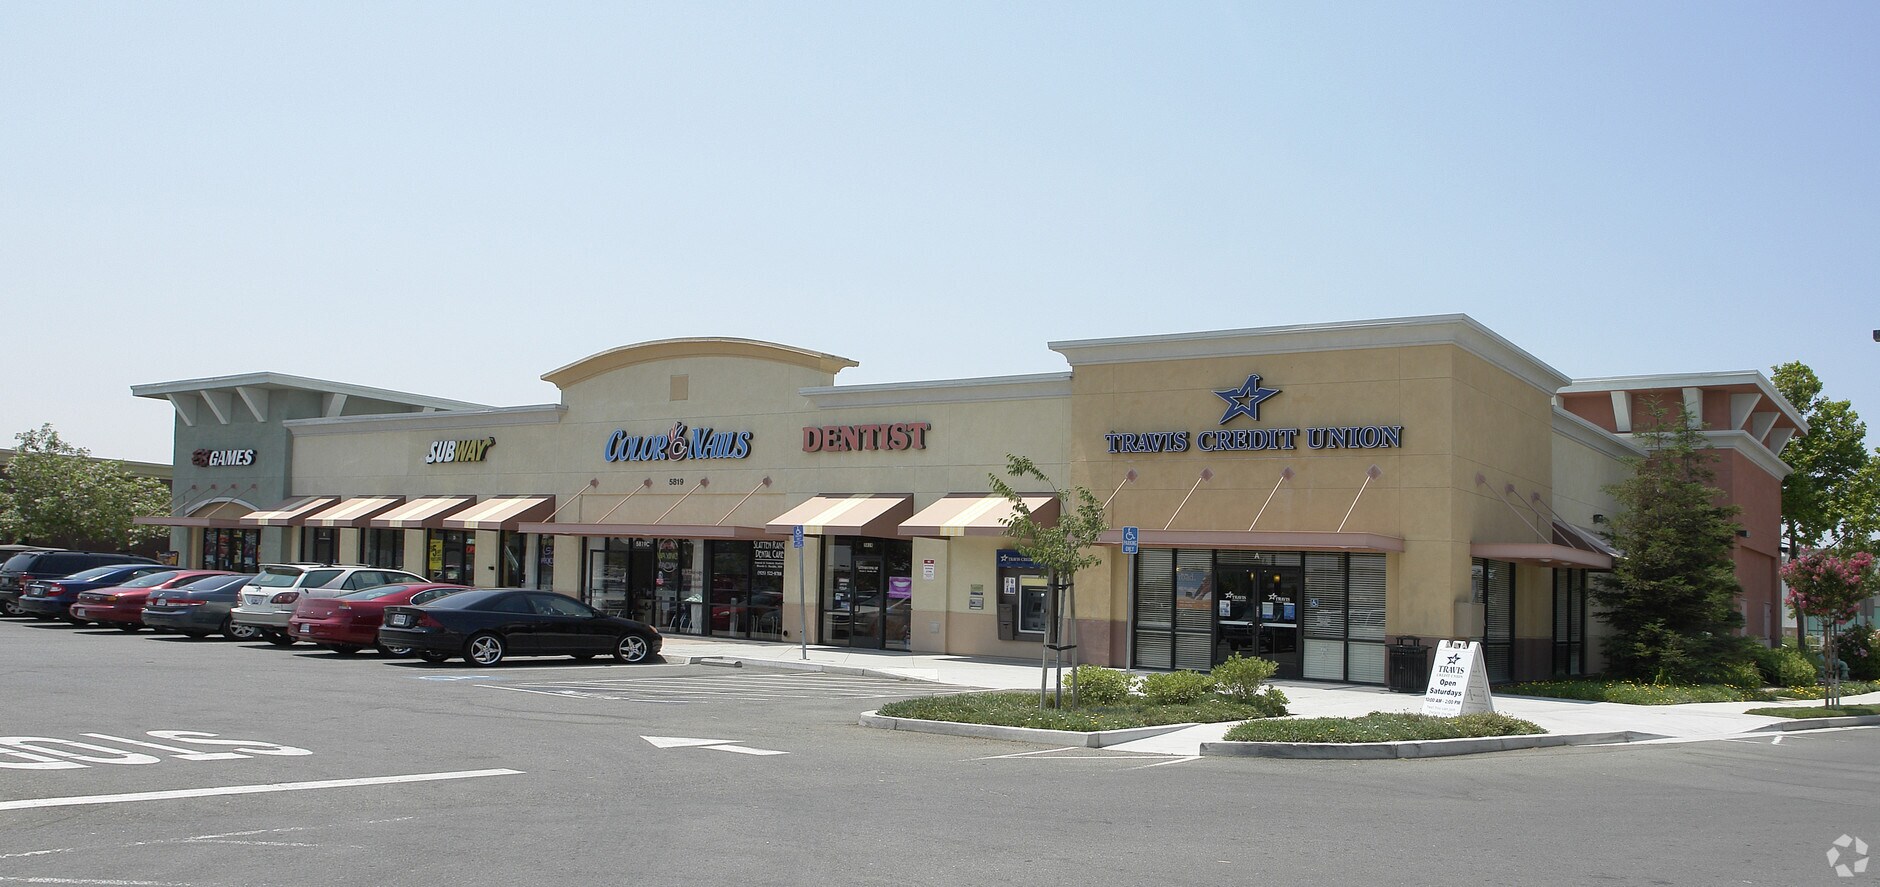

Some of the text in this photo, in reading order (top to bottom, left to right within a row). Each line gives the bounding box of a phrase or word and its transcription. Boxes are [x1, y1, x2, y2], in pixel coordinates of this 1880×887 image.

[604, 427, 754, 462] COLOR NAILS
[802, 422, 930, 453] DENTIST
[1104, 425, 1403, 453] TRAVIS CREDIT UNION
[425, 436, 496, 464] SUBWAY
[209, 449, 256, 467] GAMES
[669, 478, 684, 486] 5819
[772, 540, 784, 549] RANC
[1438, 665, 1464, 674] TRAVIS
[1439, 679, 1457, 687] Open
[1429, 687, 1462, 698] Saturdays
